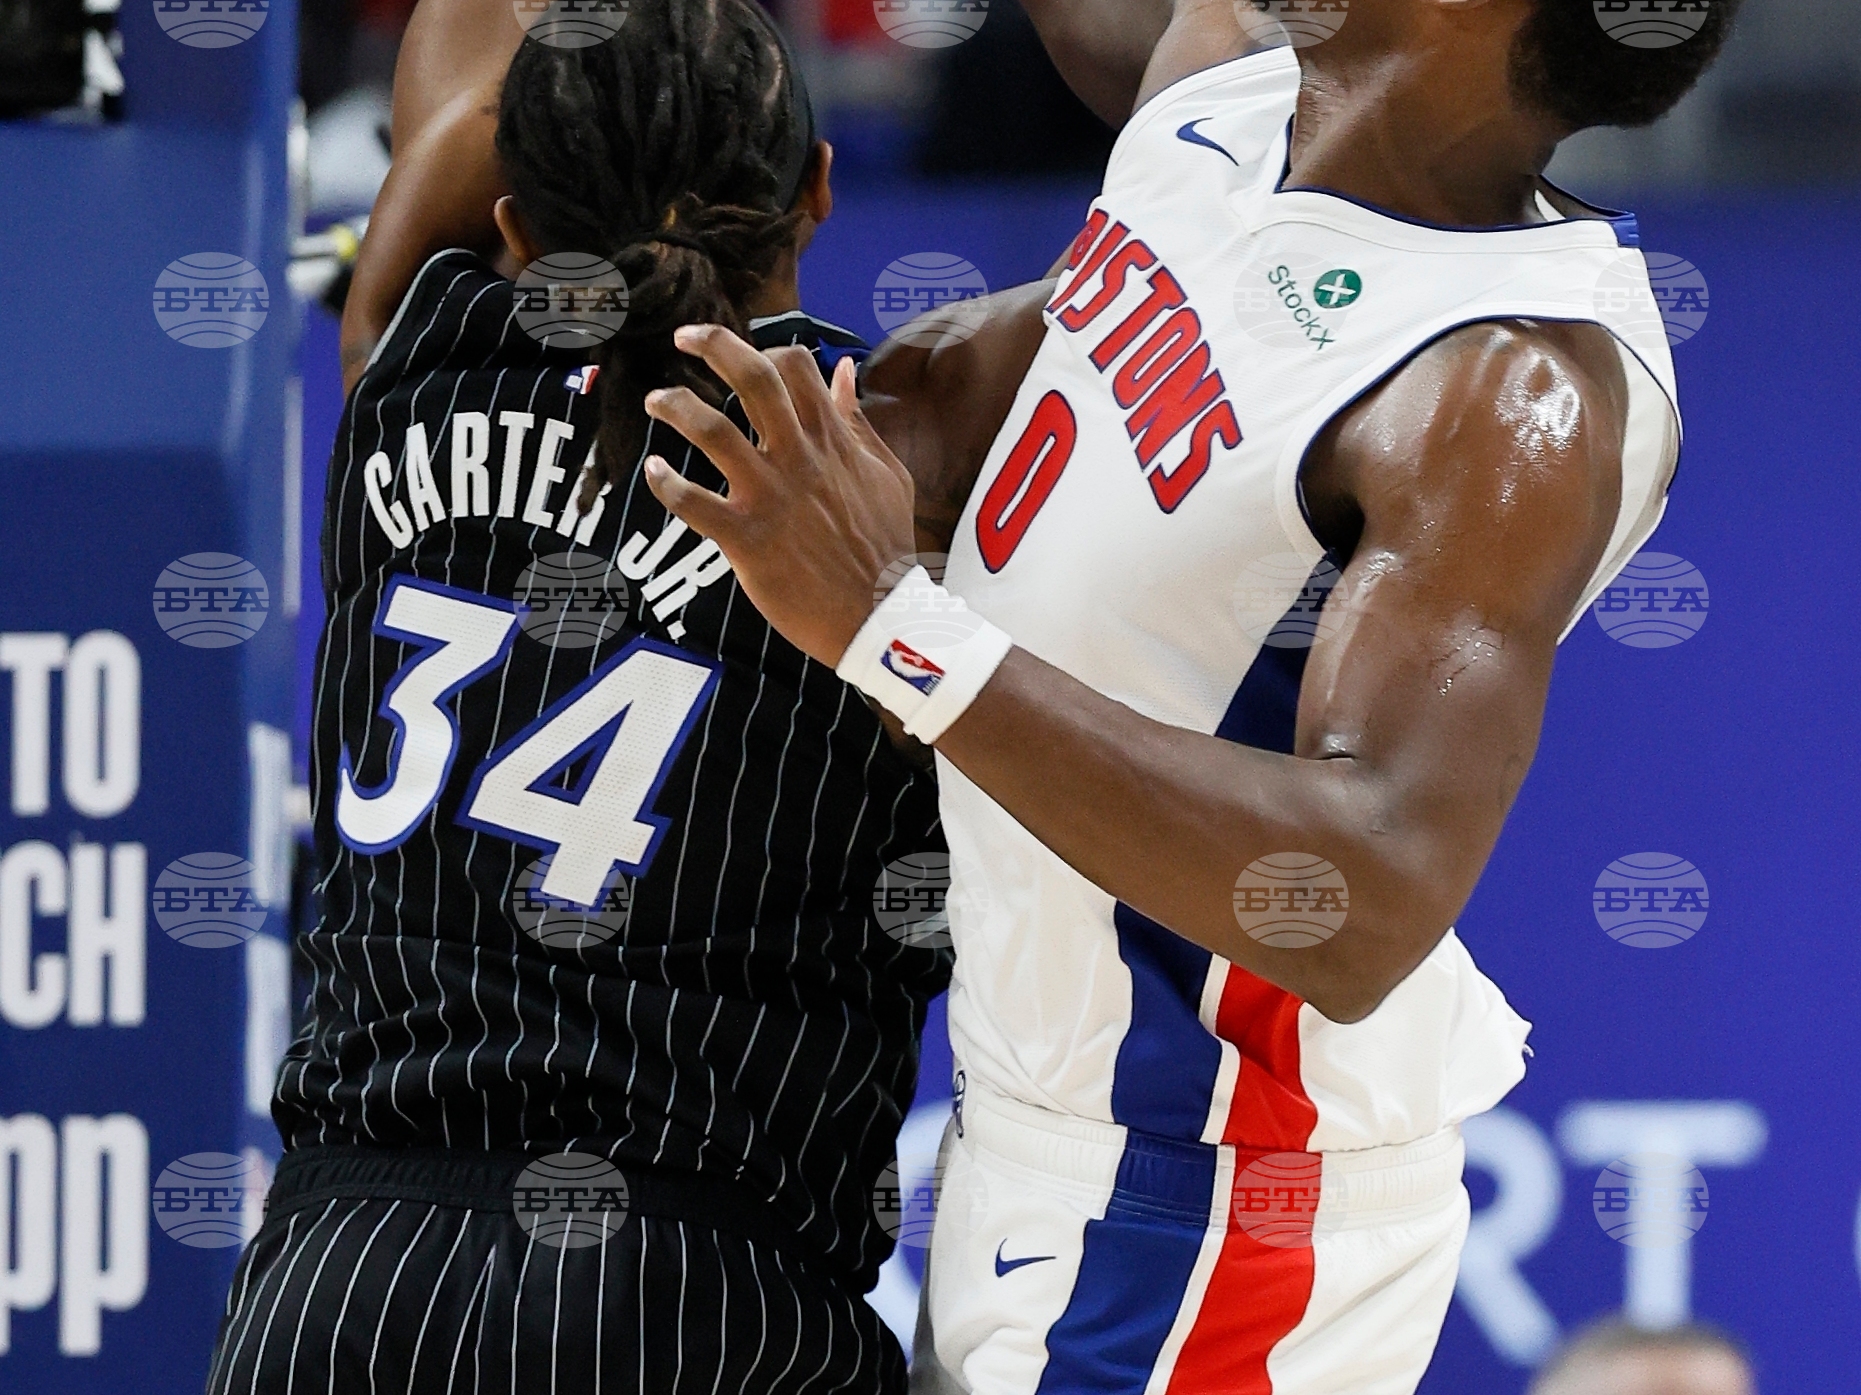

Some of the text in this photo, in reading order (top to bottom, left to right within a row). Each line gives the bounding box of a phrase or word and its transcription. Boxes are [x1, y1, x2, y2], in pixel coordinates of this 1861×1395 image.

[976, 389, 1077, 574] 0
[617, 516, 732, 641] JR.
[335, 572, 724, 919] 34
